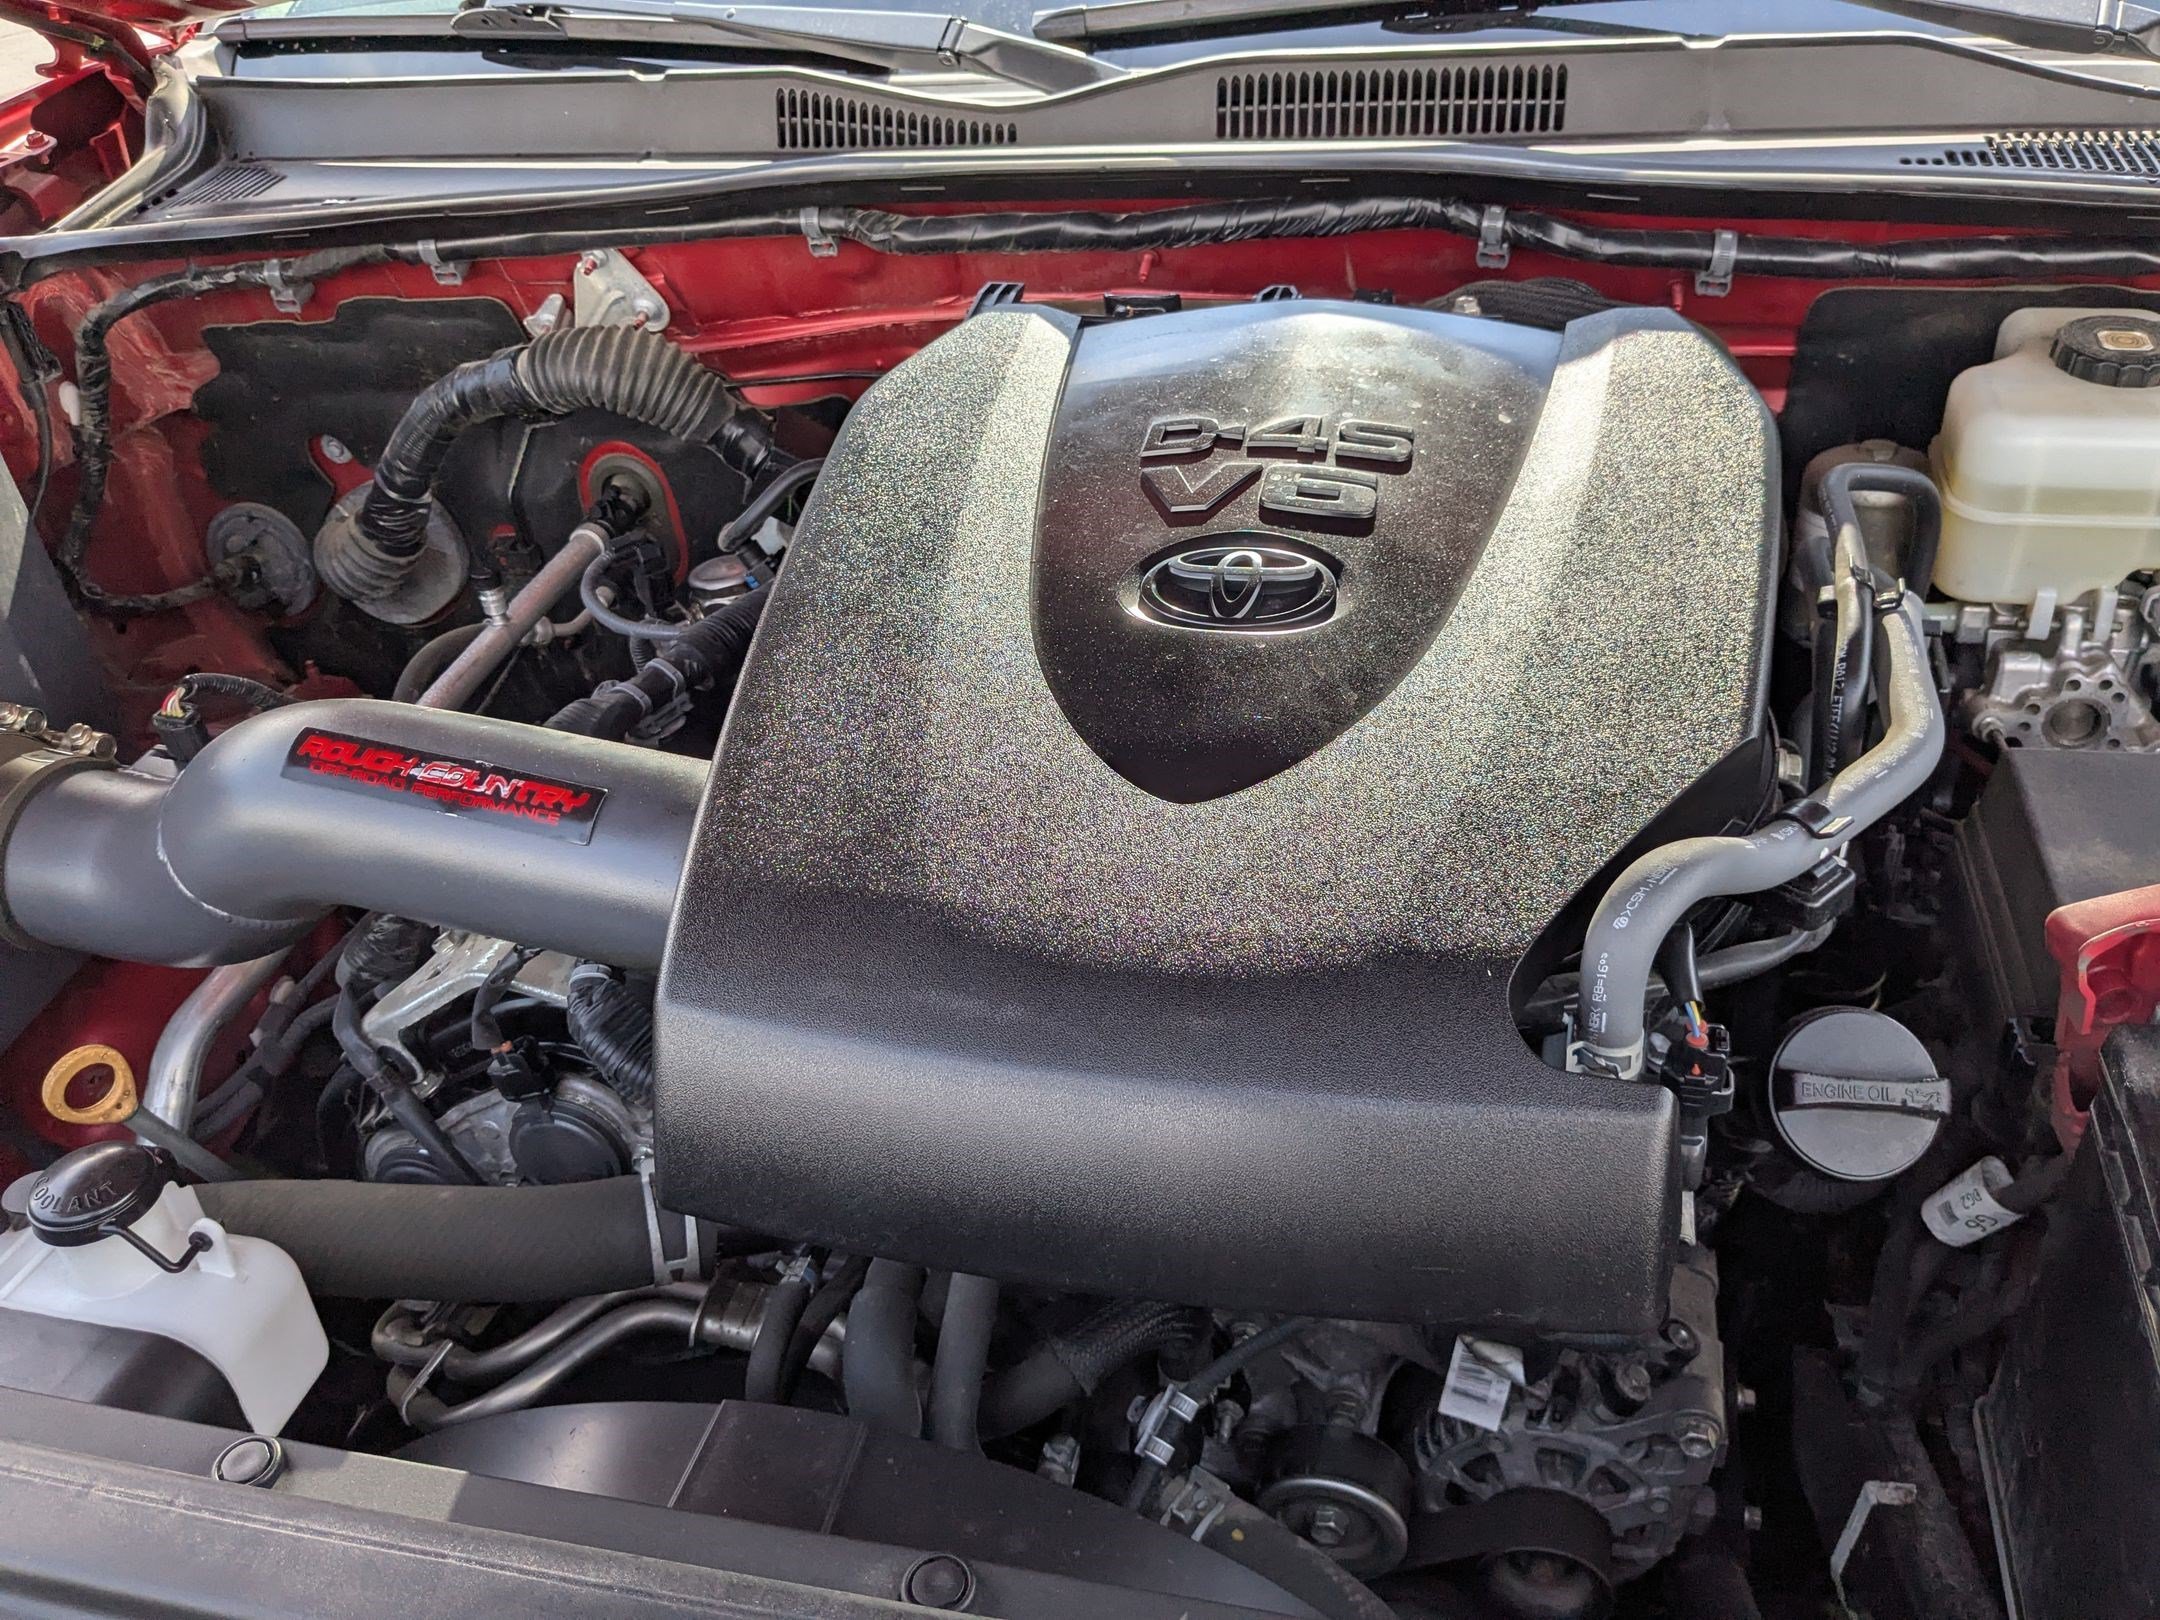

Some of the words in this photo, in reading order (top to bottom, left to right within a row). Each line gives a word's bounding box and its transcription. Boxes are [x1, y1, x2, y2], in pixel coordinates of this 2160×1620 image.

[1140, 415, 1414, 463] D-4S
[1141, 463, 1378, 518] V6
[297, 735, 420, 777] ROUGH
[416, 760, 591, 813] COUNTRY
[309, 761, 406, 792] OFF-ROAD
[411, 783, 561, 826] PERFORMANCE
[1801, 1081, 1864, 1100] ENGINE
[1867, 1085, 1897, 1102] OIL
[33, 1176, 118, 1215] COOLANT
